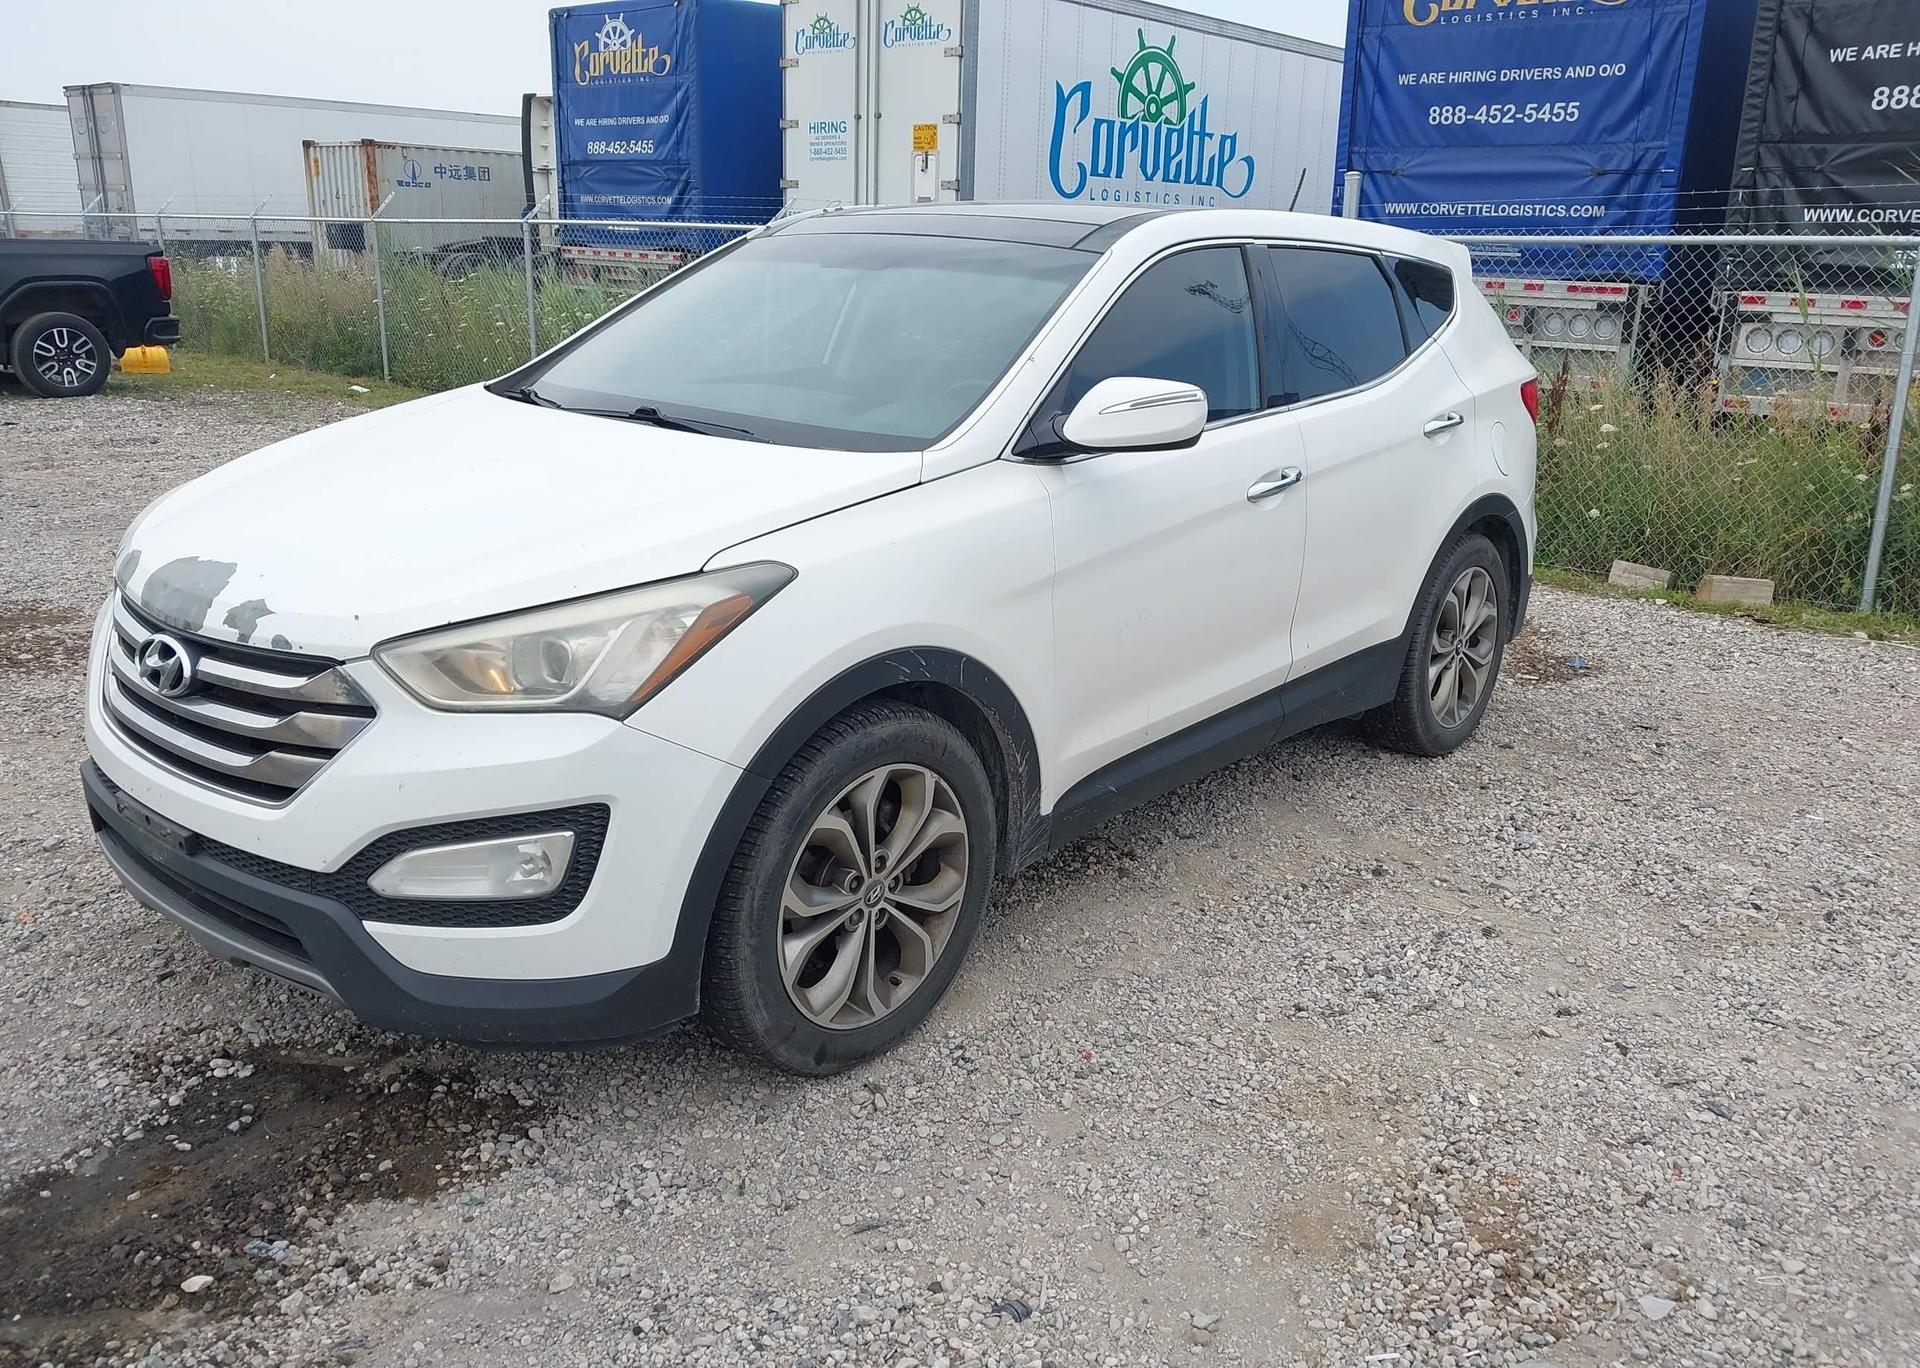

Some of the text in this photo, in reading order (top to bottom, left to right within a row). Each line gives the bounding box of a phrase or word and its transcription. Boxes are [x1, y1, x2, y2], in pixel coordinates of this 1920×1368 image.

[1440, 9, 1539, 25] LOGISTICS
[1552, 6, 1596, 17] INC.
[795, 25, 856, 55] Corvette
[884, 16, 952, 48] Corvette
[574, 32, 671, 86] Corvette
[1830, 47, 1858, 63] WE
[1861, 43, 1903, 60] ARE
[1398, 63, 1626, 86] WE ARE HIRING DRIVERS AND O/O
[574, 118, 585, 126] WE
[585, 118, 598, 126] ARE
[598, 118, 617, 126] HIRING
[618, 116, 645, 126] DRIVERS
[646, 116, 658, 124] AND
[1428, 102, 1581, 125] 888-452-5455
[808, 120, 847, 135] HIRING
[587, 140, 654, 155] 888-452-5455
[1049, 79, 1255, 200] Corvette
[434, 163, 490, 182] 中远集团
[580, 195, 672, 206] WWW.CORVETTELOGISTICS.COM
[1090, 188, 1216, 208] LOGISTICS INC
[1384, 203, 1605, 218] WWW.CORVETTELOGISTICS.COM
